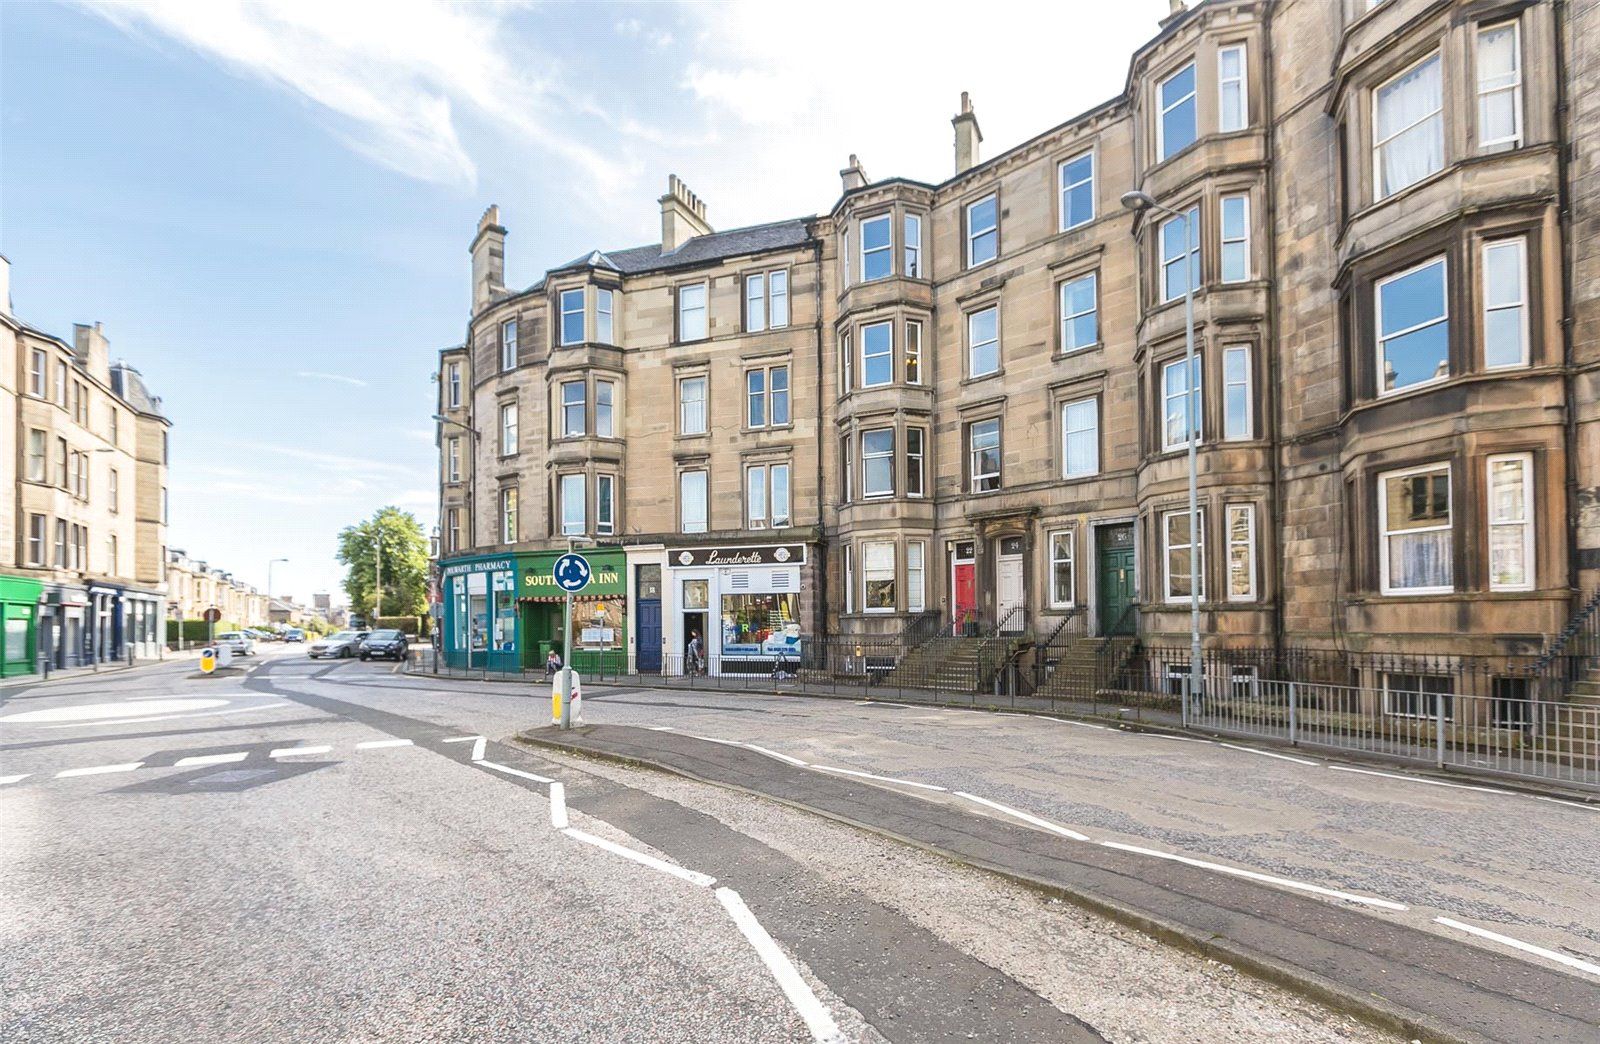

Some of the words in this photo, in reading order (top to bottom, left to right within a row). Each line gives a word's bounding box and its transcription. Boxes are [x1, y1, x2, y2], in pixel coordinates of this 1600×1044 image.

[1117, 532, 1127, 541] 26
[965, 546, 973, 554] 22
[1010, 541, 1019, 549] 24
[705, 550, 762, 565] Launderette
[475, 560, 511, 572] PHARMACY
[599, 572, 618, 584] INN
